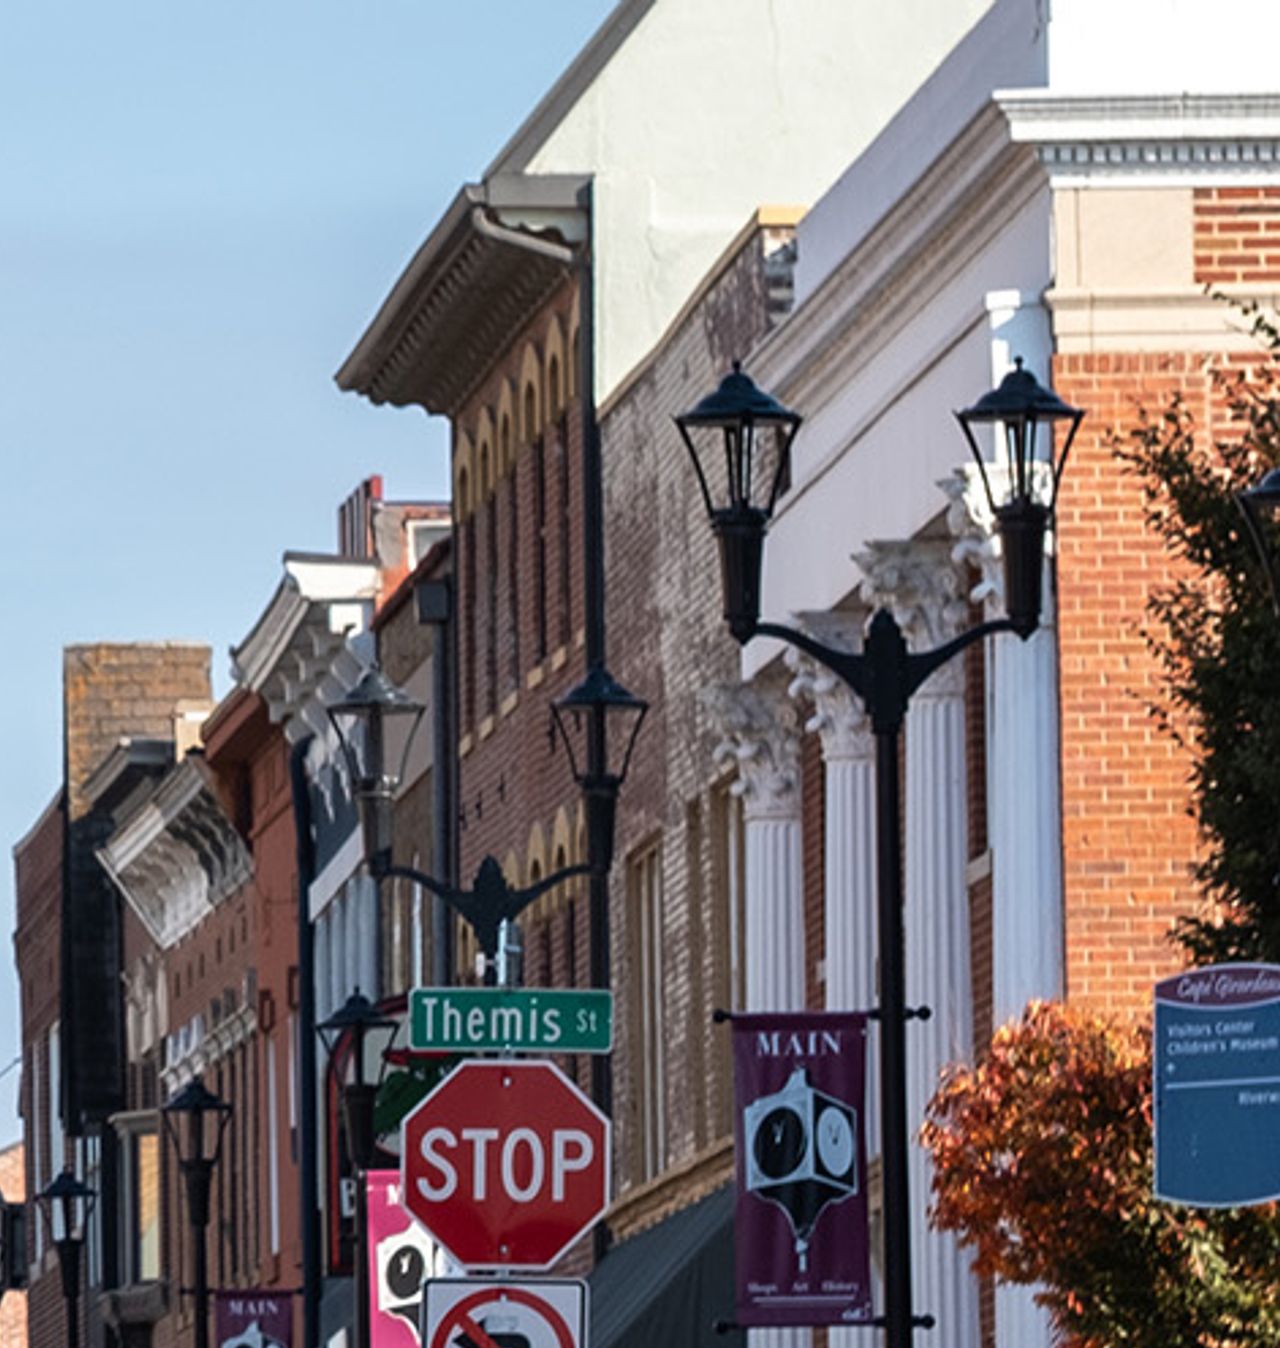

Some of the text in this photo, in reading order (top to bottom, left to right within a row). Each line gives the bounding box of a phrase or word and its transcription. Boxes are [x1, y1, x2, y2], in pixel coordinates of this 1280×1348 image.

[422, 998, 597, 1042] Themis St
[1167, 1021, 1254, 1038] Visitors Center
[756, 1030, 840, 1057] MAIN
[1230, 1037, 1279, 1052] Museum
[416, 1127, 594, 1203] STOP
[228, 1300, 279, 1315] MAIN
